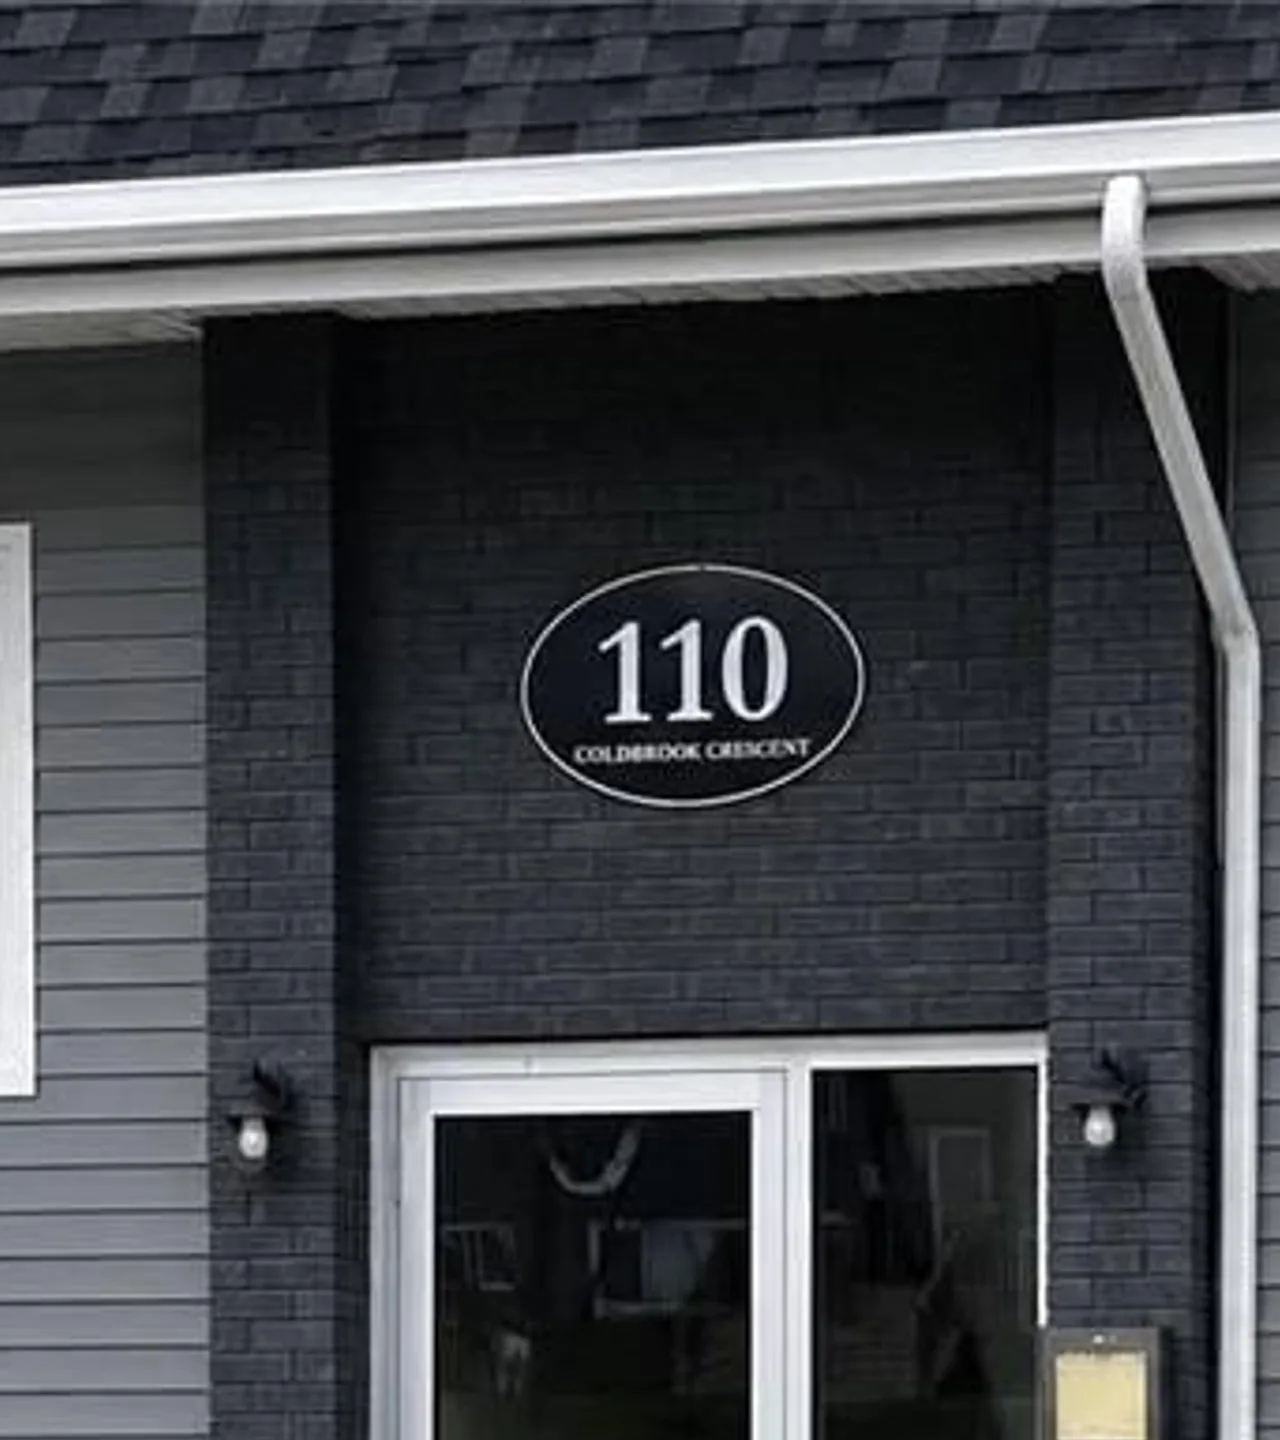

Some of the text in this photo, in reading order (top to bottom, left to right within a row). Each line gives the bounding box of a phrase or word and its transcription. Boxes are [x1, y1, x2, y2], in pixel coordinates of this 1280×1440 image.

[598, 615, 788, 723] 110
[573, 739, 811, 764] COLDBROOK CRESCENT
